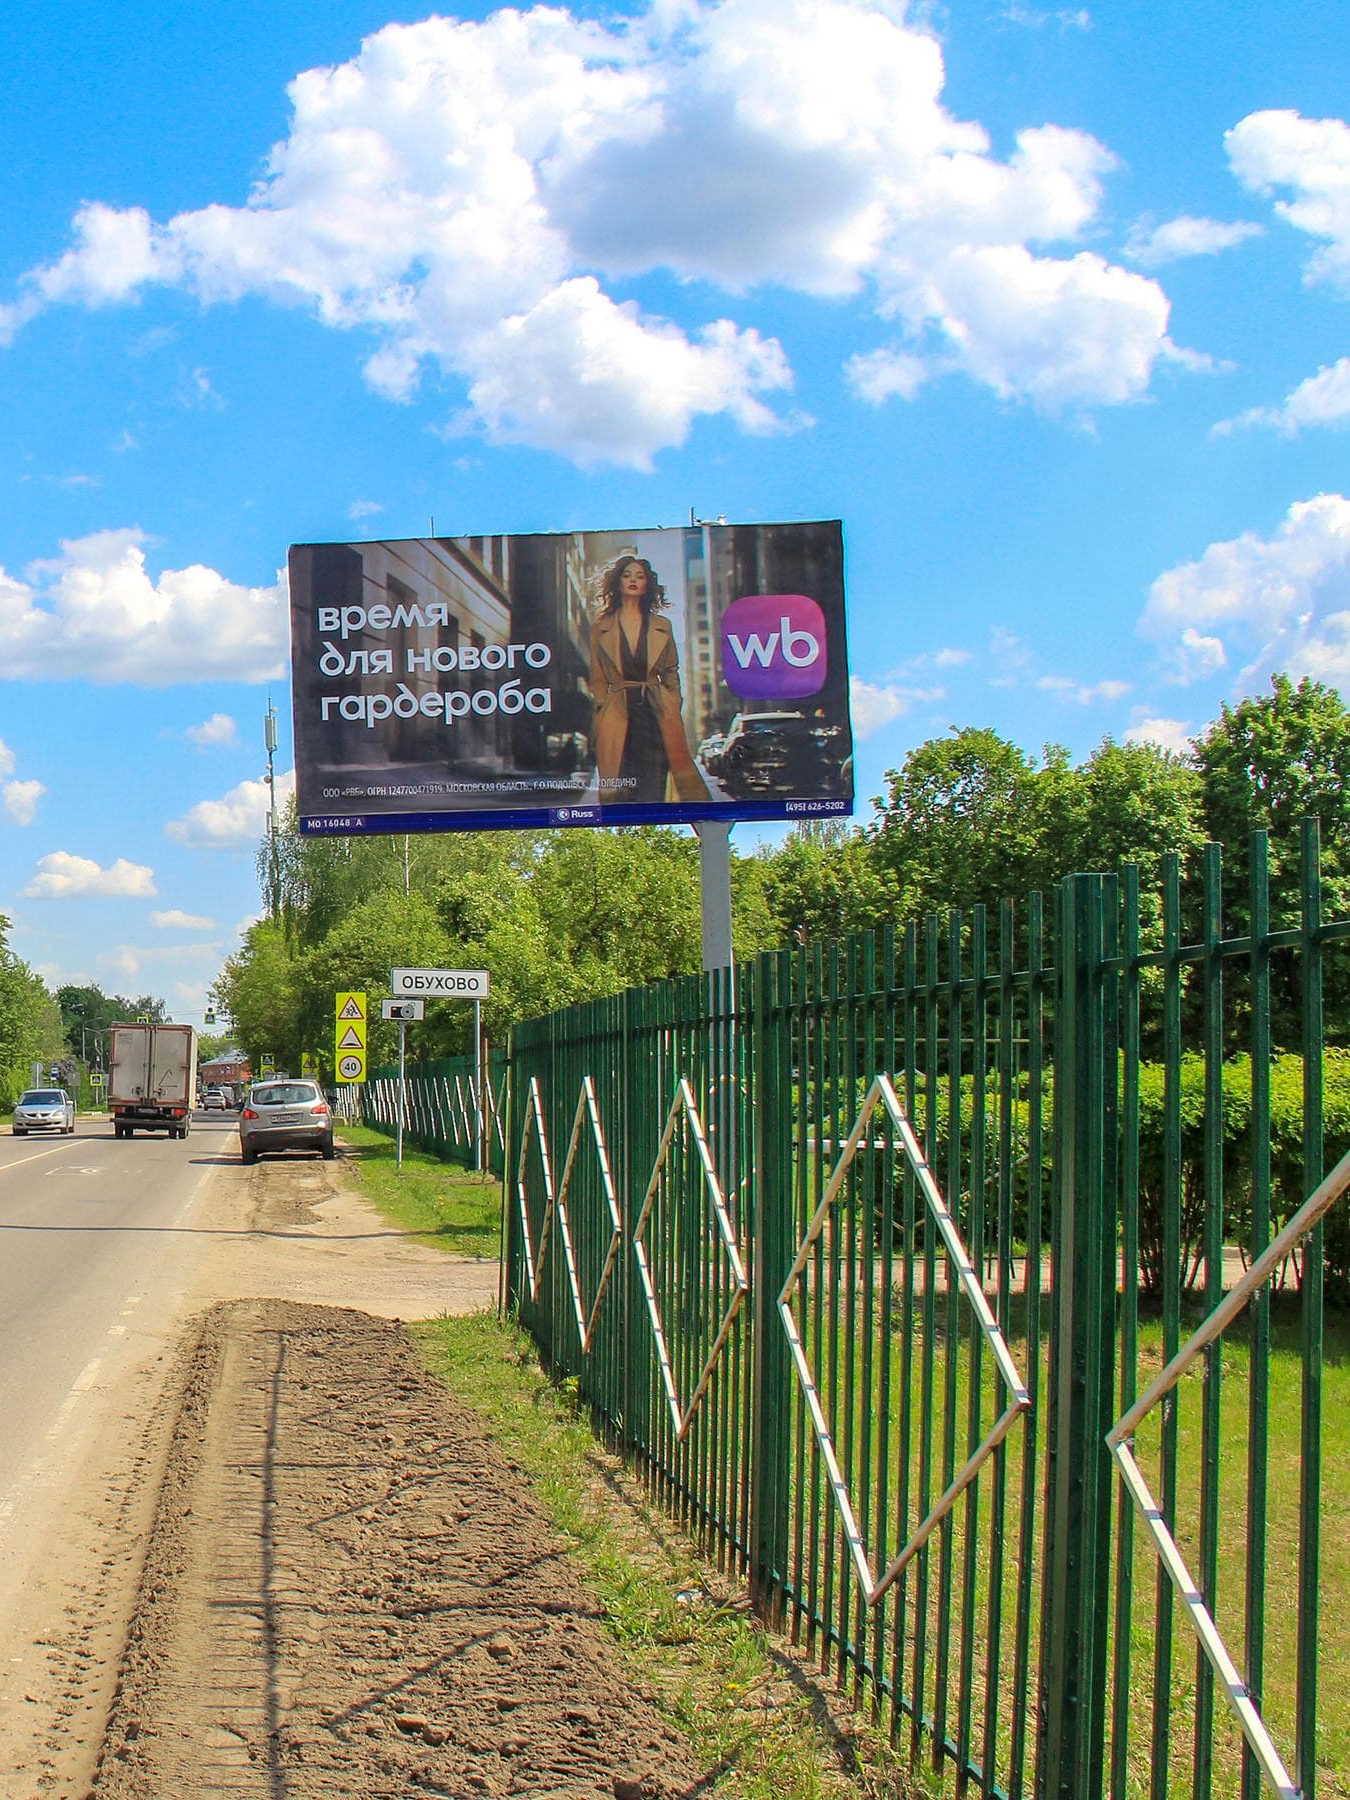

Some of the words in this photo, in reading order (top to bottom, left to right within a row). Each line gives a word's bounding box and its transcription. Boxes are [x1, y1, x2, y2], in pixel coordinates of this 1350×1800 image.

[318, 602, 449, 640] время
[726, 616, 820, 669] wb
[319, 641, 394, 677] для
[406, 642, 552, 674] нового
[320, 678, 552, 729] гардероба
[322, 787, 340, 798] ООО
[367, 785, 387, 796] ОГРН
[807, 800, 845, 811] 626-5202
[571, 809, 594, 819] Russ
[323, 818, 351, 828] 16048
[402, 974, 480, 991] ОБУХОВО
[344, 1061, 357, 1072] 40
